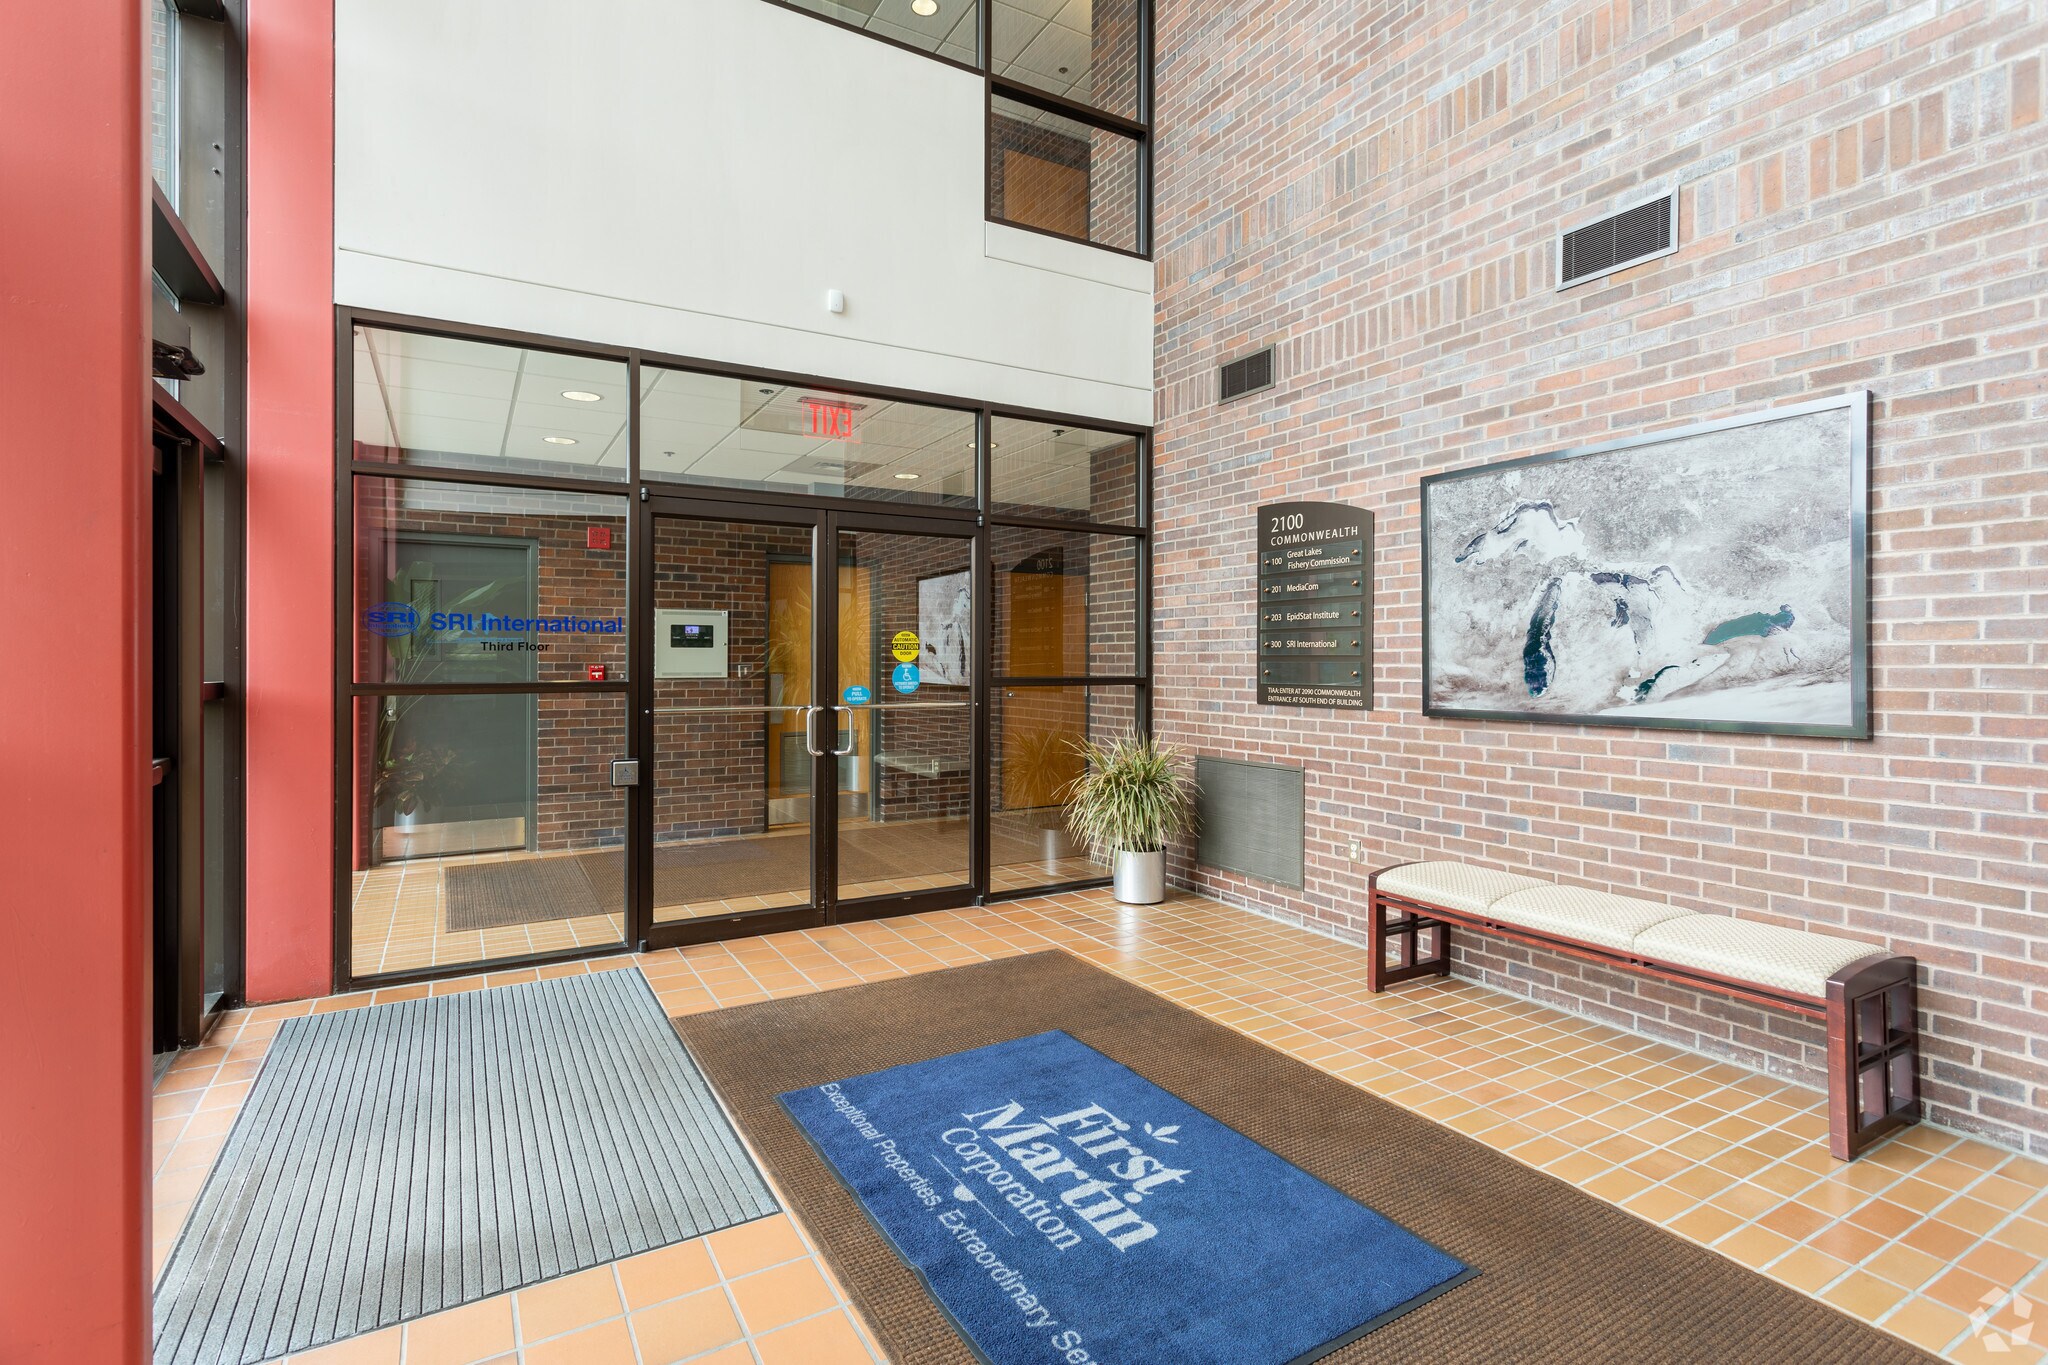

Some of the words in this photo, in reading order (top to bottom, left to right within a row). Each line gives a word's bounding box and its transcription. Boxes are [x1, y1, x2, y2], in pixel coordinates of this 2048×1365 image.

[1271, 513, 1304, 533] 2100
[1271, 526, 1358, 546] COMMONWEALTH
[1287, 550, 1304, 559] Great
[1304, 547, 1322, 557] Lakes
[1271, 557, 1282, 565] 100
[1288, 560, 1309, 570] Fishery
[1310, 556, 1350, 567] Commission
[1287, 582, 1319, 592] MediaCom
[368, 611, 415, 622] SRI
[1271, 613, 1282, 621] 203
[1287, 612, 1312, 622] EpidStat
[1312, 610, 1339, 620] Institute
[430, 613, 472, 631] SRI
[482, 613, 623, 633] International
[481, 641, 514, 652] Third
[518, 641, 550, 652] Floor
[1271, 640, 1282, 648] 300
[1286, 640, 1296, 648] SRI
[1297, 639, 1337, 648] International
[1314, 688, 1361, 697] COMMONWEALTH
[1268, 695, 1291, 703] ENTRANCE
[1317, 697, 1328, 705] END
[1337, 698, 1363, 707] BUILDING
[1041, 1102, 1192, 1195] First
[962, 1099, 1159, 1253] Martin
[941, 1127, 1081, 1251] Corporation
[819, 1083, 881, 1149] Exceptional
[876, 1139, 943, 1211] Properties,
[938, 1209, 1057, 1329] Extraordinary
